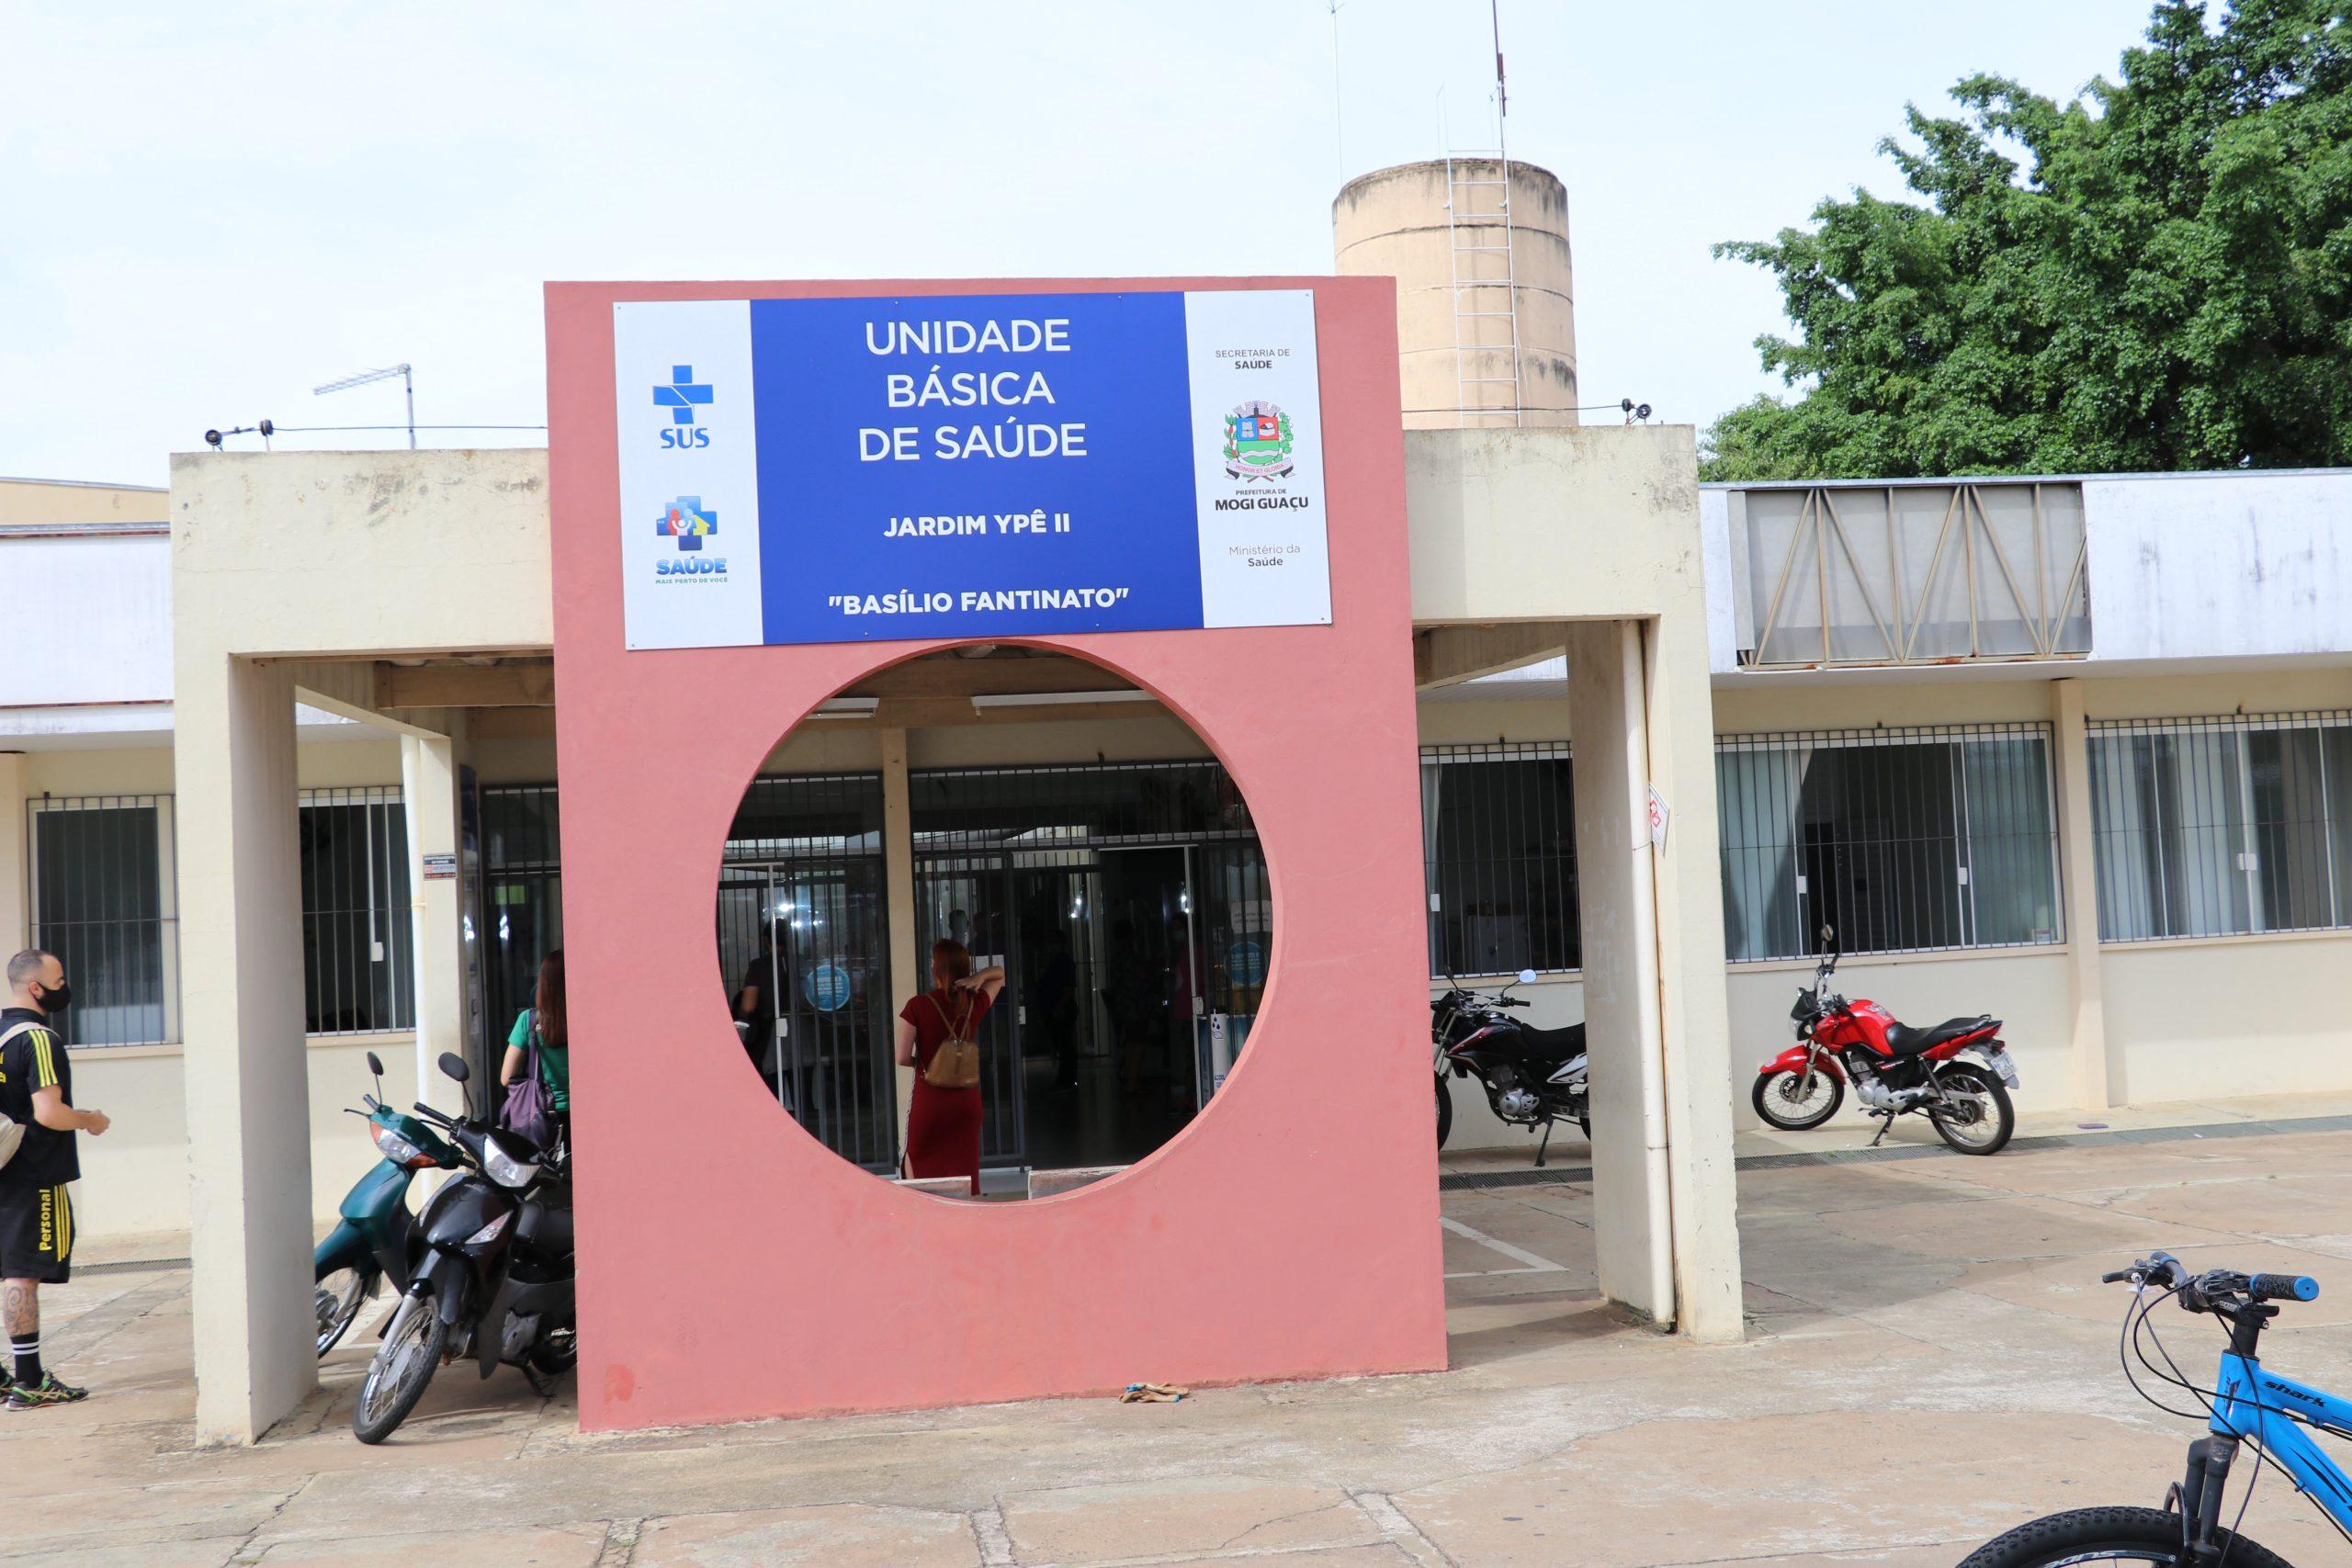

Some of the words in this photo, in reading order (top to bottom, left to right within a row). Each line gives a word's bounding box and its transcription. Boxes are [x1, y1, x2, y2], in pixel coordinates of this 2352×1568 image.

[866, 318, 1071, 355] UNIDADE
[1215, 349, 1275, 358] SECRETARIA
[1277, 348, 1291, 357] DE
[1234, 358, 1273, 370] SAÚDE
[887, 364, 1056, 408] BÁSICA
[660, 427, 711, 450] SUS
[859, 426, 921, 462] DE
[934, 415, 1088, 460] SAÚDE
[1236, 465, 1255, 473] HONOR
[1264, 463, 1284, 472] GLORIA
[1215, 498, 1255, 512] MOGI
[1257, 496, 1309, 513] GUAÇU
[883, 514, 987, 537] JARDIM
[993, 509, 1046, 535] YPÊ
[1055, 513, 1070, 533] II
[1228, 546, 1283, 557] Ministério
[1285, 544, 1301, 554] da
[655, 555, 728, 576] SAÚDE
[1247, 557, 1283, 568] Saúde
[829, 588, 954, 616] "BASÍLIO
[961, 587, 1129, 613] FANTINATO"
[39, 1189, 52, 1251] Personal
[2263, 1380, 2326, 1409] shark
